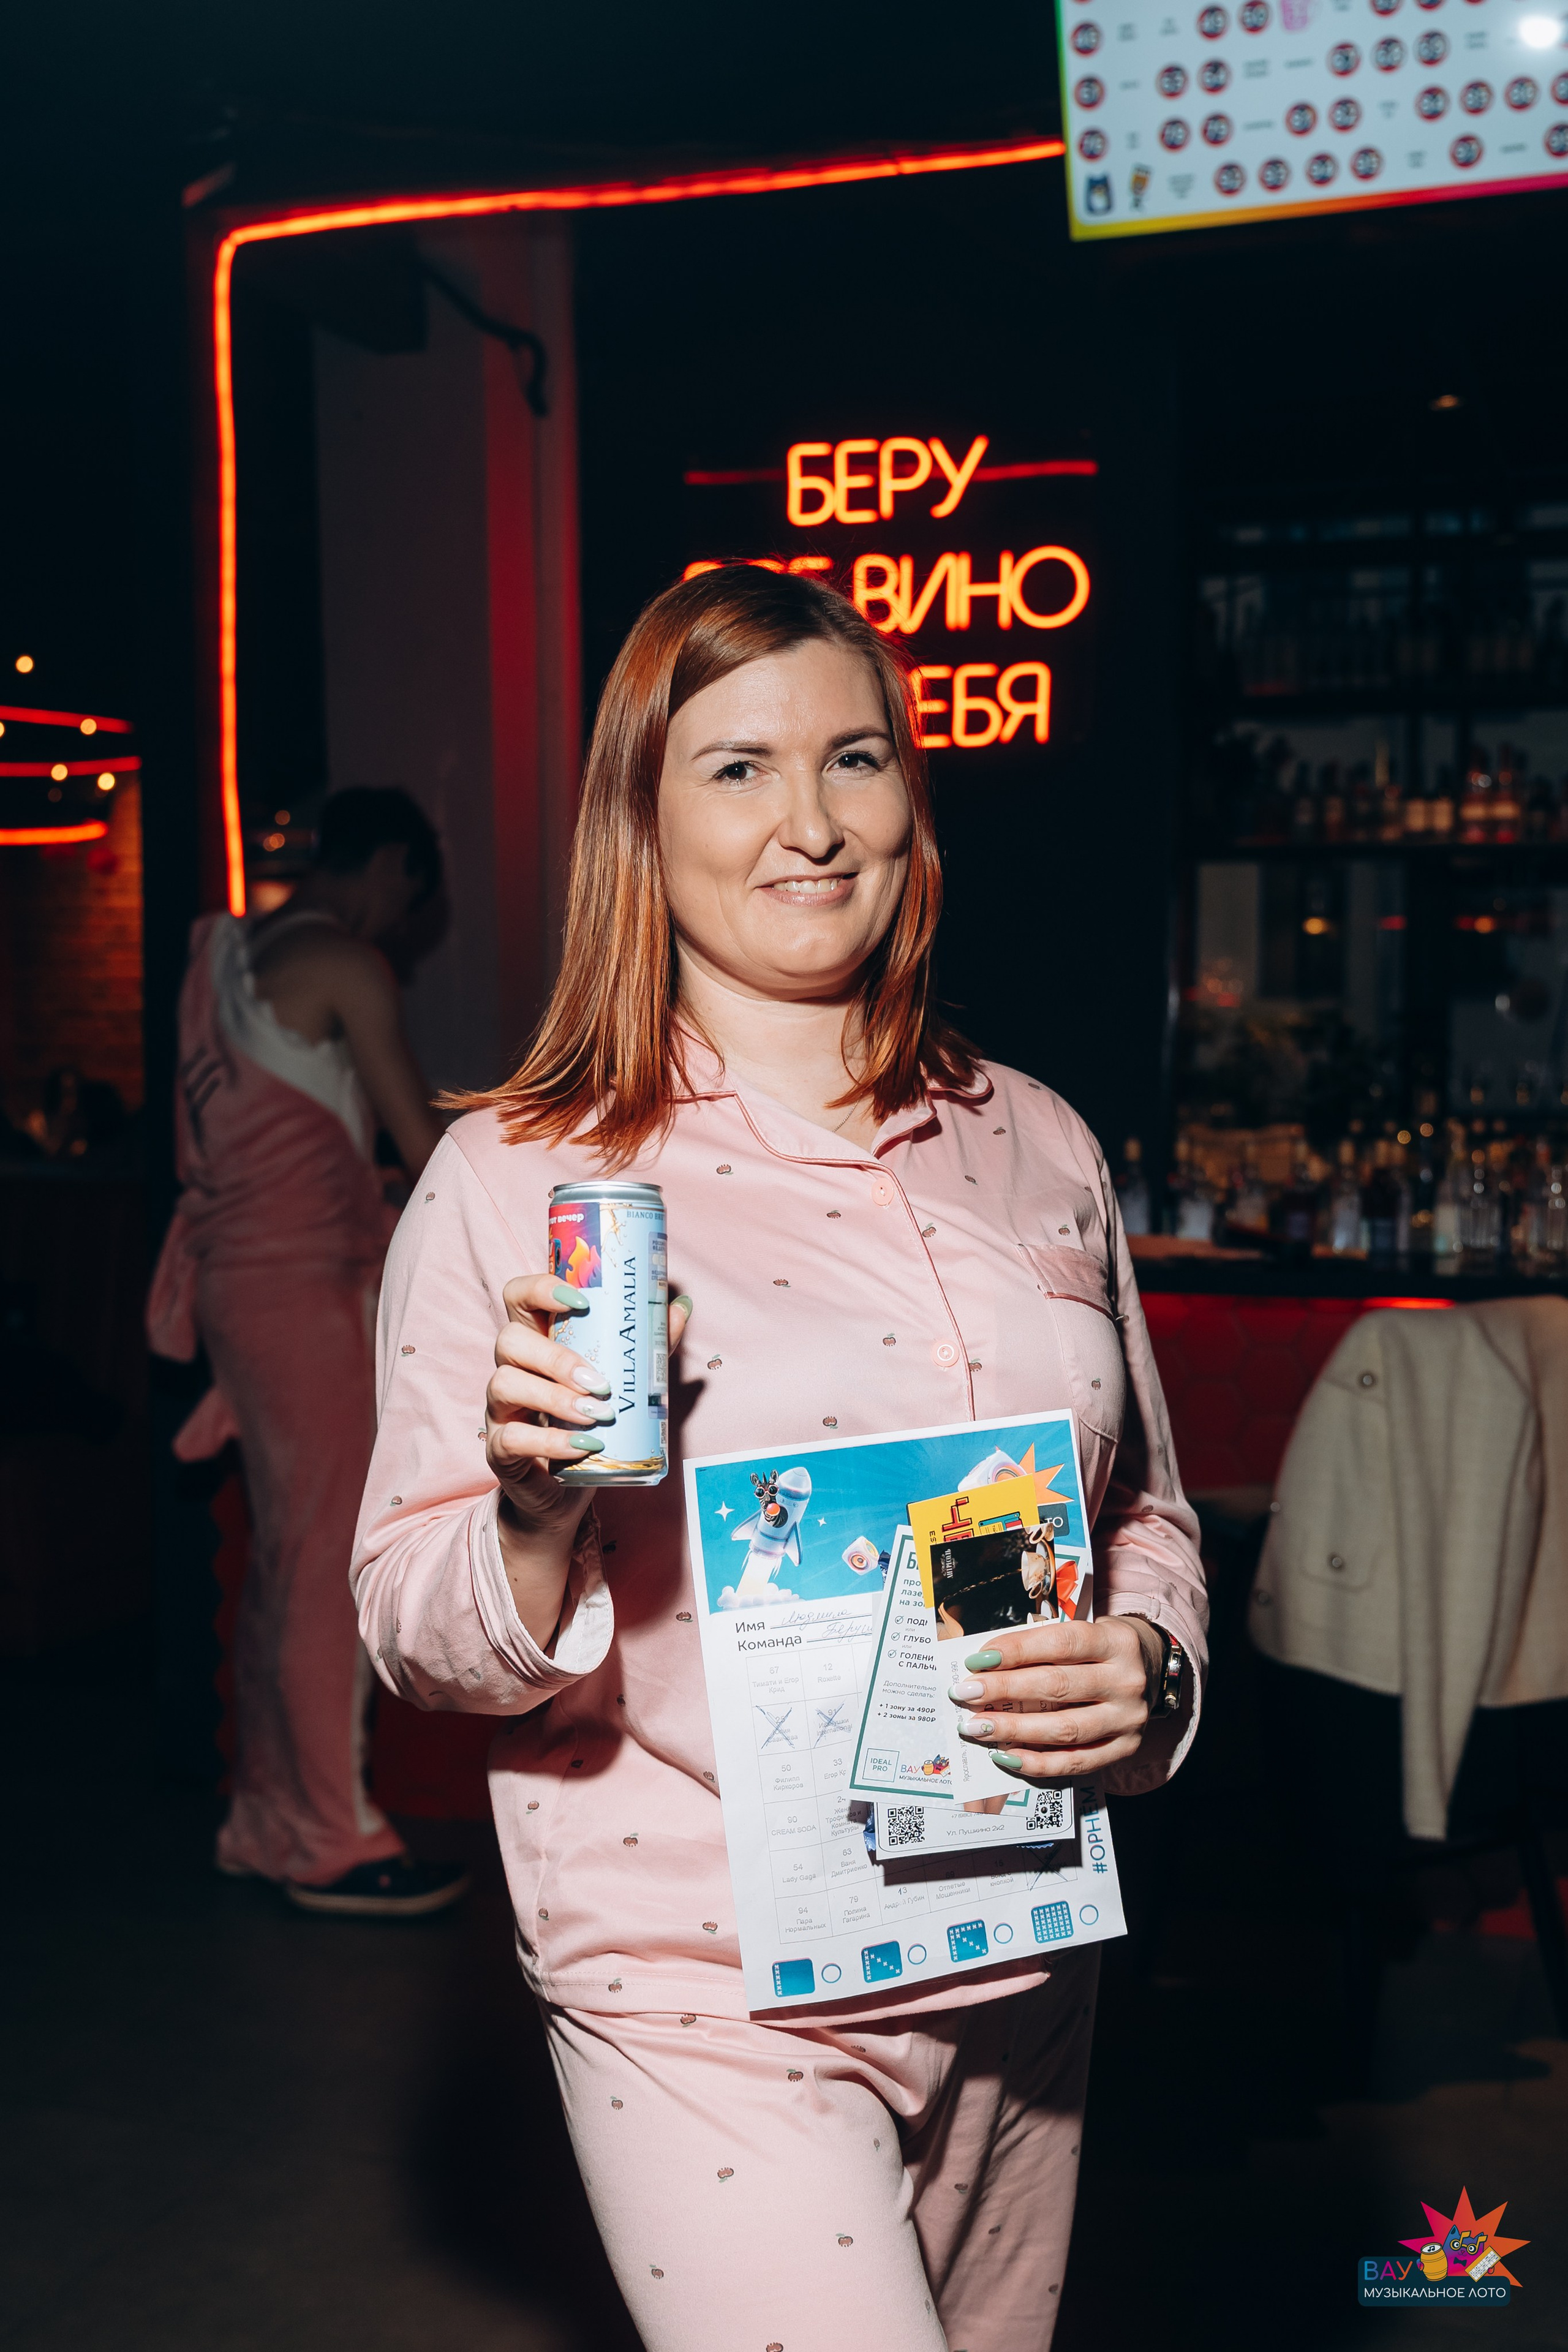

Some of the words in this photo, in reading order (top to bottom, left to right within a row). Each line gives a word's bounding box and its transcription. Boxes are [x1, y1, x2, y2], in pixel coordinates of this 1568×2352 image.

[787, 435, 989, 526] БЕРУ
[853, 545, 1090, 634] ВИНО
[910, 661, 1051, 748] ЕБЯ
[557, 1213, 584, 1223] вечер
[619, 1257, 636, 1344] AMALIA
[619, 1348, 635, 1414] VILLA
[901, 1589, 923, 1597] лазе
[736, 1622, 765, 1633] Имя
[737, 1635, 802, 1651] Команда
[900, 1652, 934, 1662] ГОЛЕНИ
[785, 1676, 799, 1685] Егор
[883, 1680, 937, 1692] Дополнительно
[899, 1775, 938, 1784] МУЗЫКАЛЬНОЕ
[771, 1828, 796, 1836] CREAM
[797, 1825, 816, 1833] SODA
[831, 1825, 859, 1836] Культуры
[959, 1826, 990, 1836] Пушкина
[831, 1864, 867, 1878] Дмитриенко
[799, 1873, 816, 1882] Gaga
[936, 1887, 971, 1900] Мошенники
[844, 1906, 867, 1916] Полина
[842, 1913, 870, 1923] Гагарина
[785, 1923, 826, 1933] Нормальных
